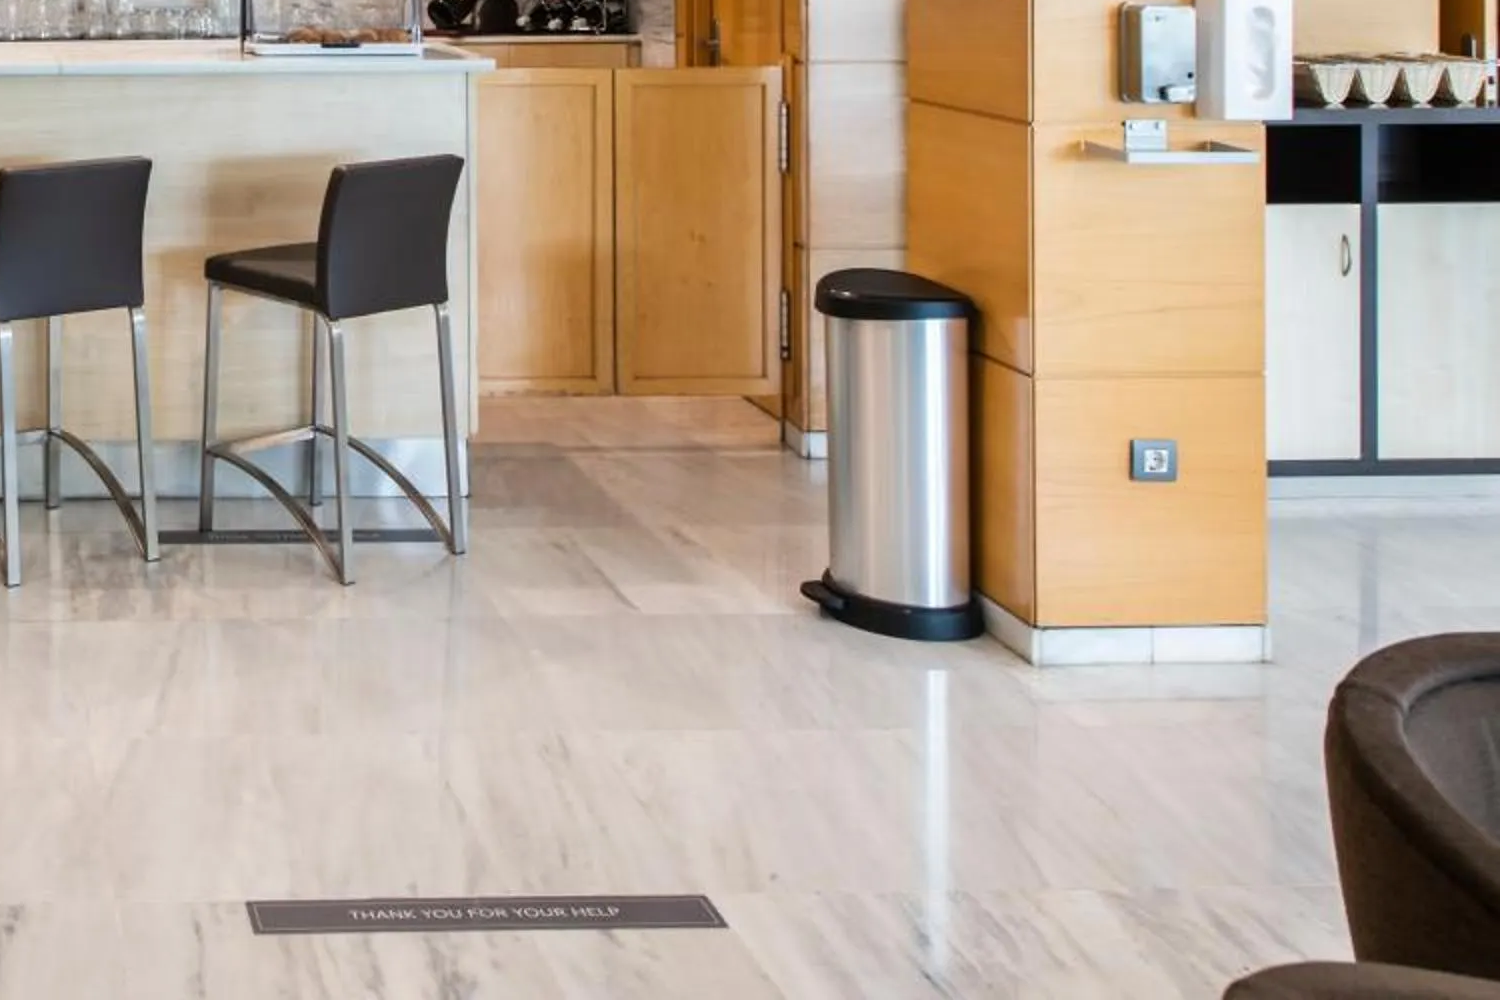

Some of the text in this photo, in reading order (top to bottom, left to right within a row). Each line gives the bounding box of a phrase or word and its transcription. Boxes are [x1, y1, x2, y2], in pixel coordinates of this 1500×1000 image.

[349, 906, 619, 920] THANK YOU FOR YOUR HELP
